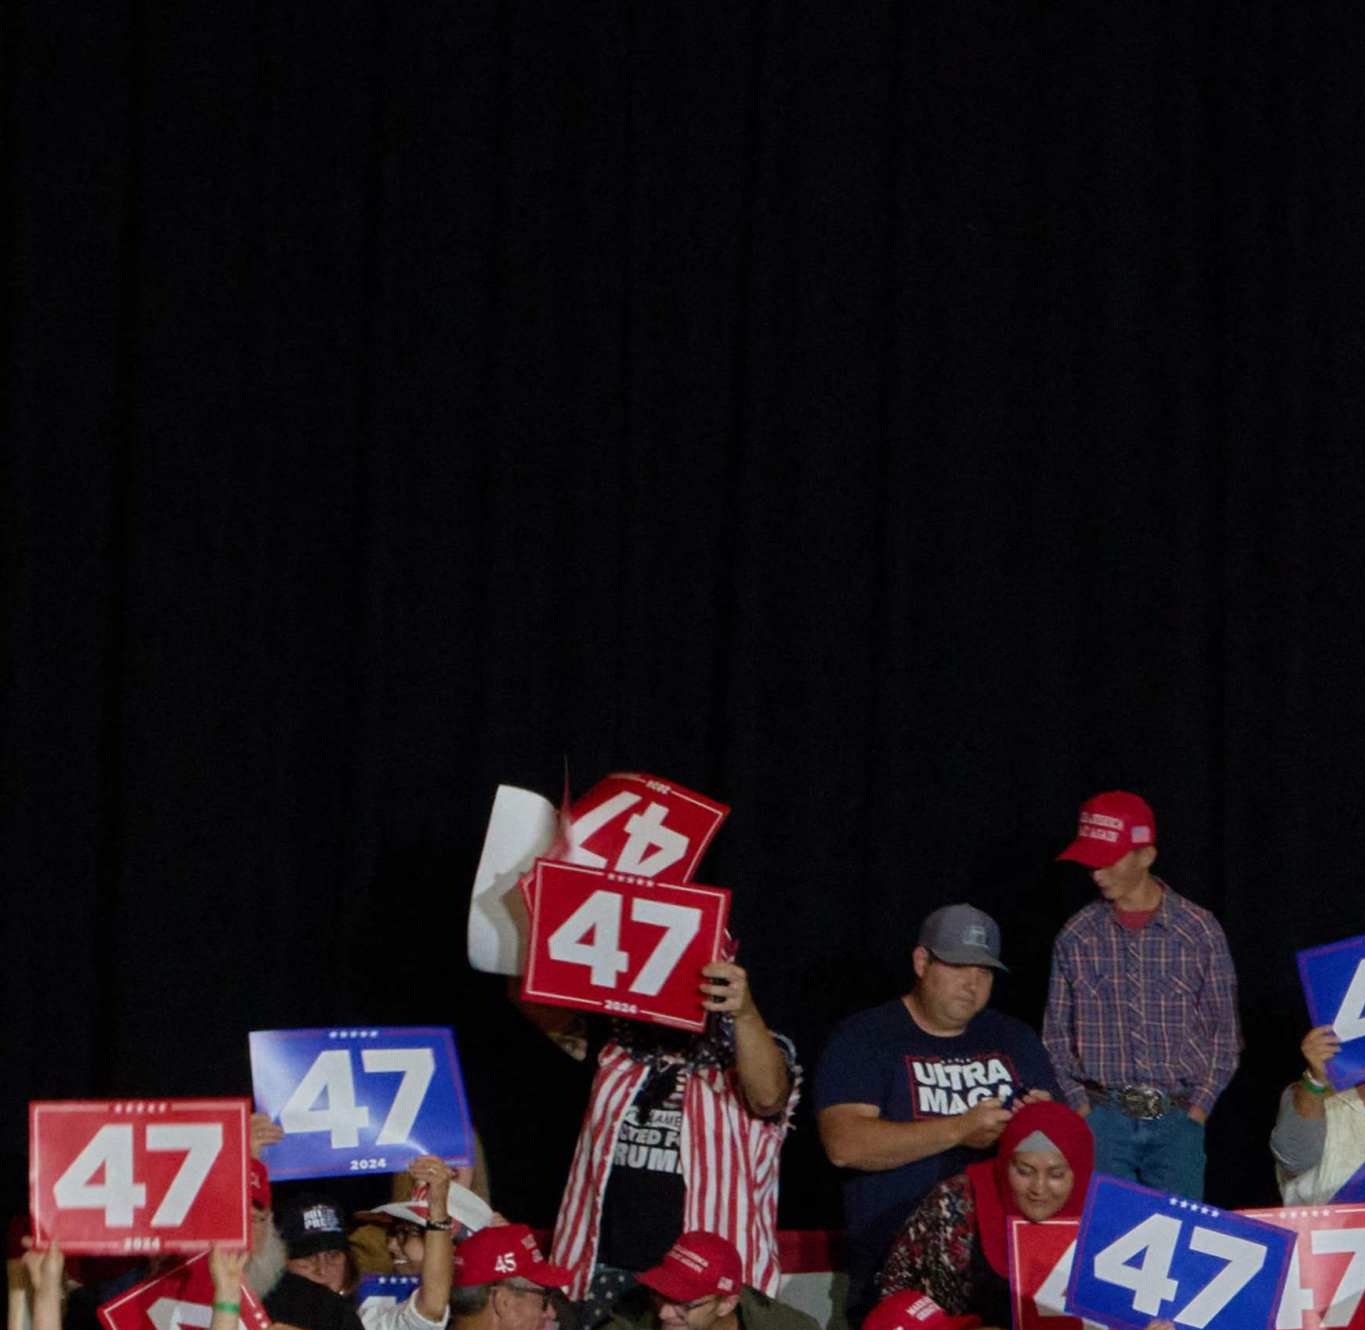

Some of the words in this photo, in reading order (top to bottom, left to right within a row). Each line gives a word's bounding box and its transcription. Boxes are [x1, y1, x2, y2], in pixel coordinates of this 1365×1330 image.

[548, 890, 702, 996] 47
[605, 1001, 637, 1014] 2024
[279, 1048, 435, 1148] 47
[912, 1059, 1013, 1088] ULTRA
[53, 1124, 223, 1228] 47
[350, 1158, 386, 1170] 2024
[495, 1252, 517, 1273] 45
[1094, 1213, 1268, 1330] 47
